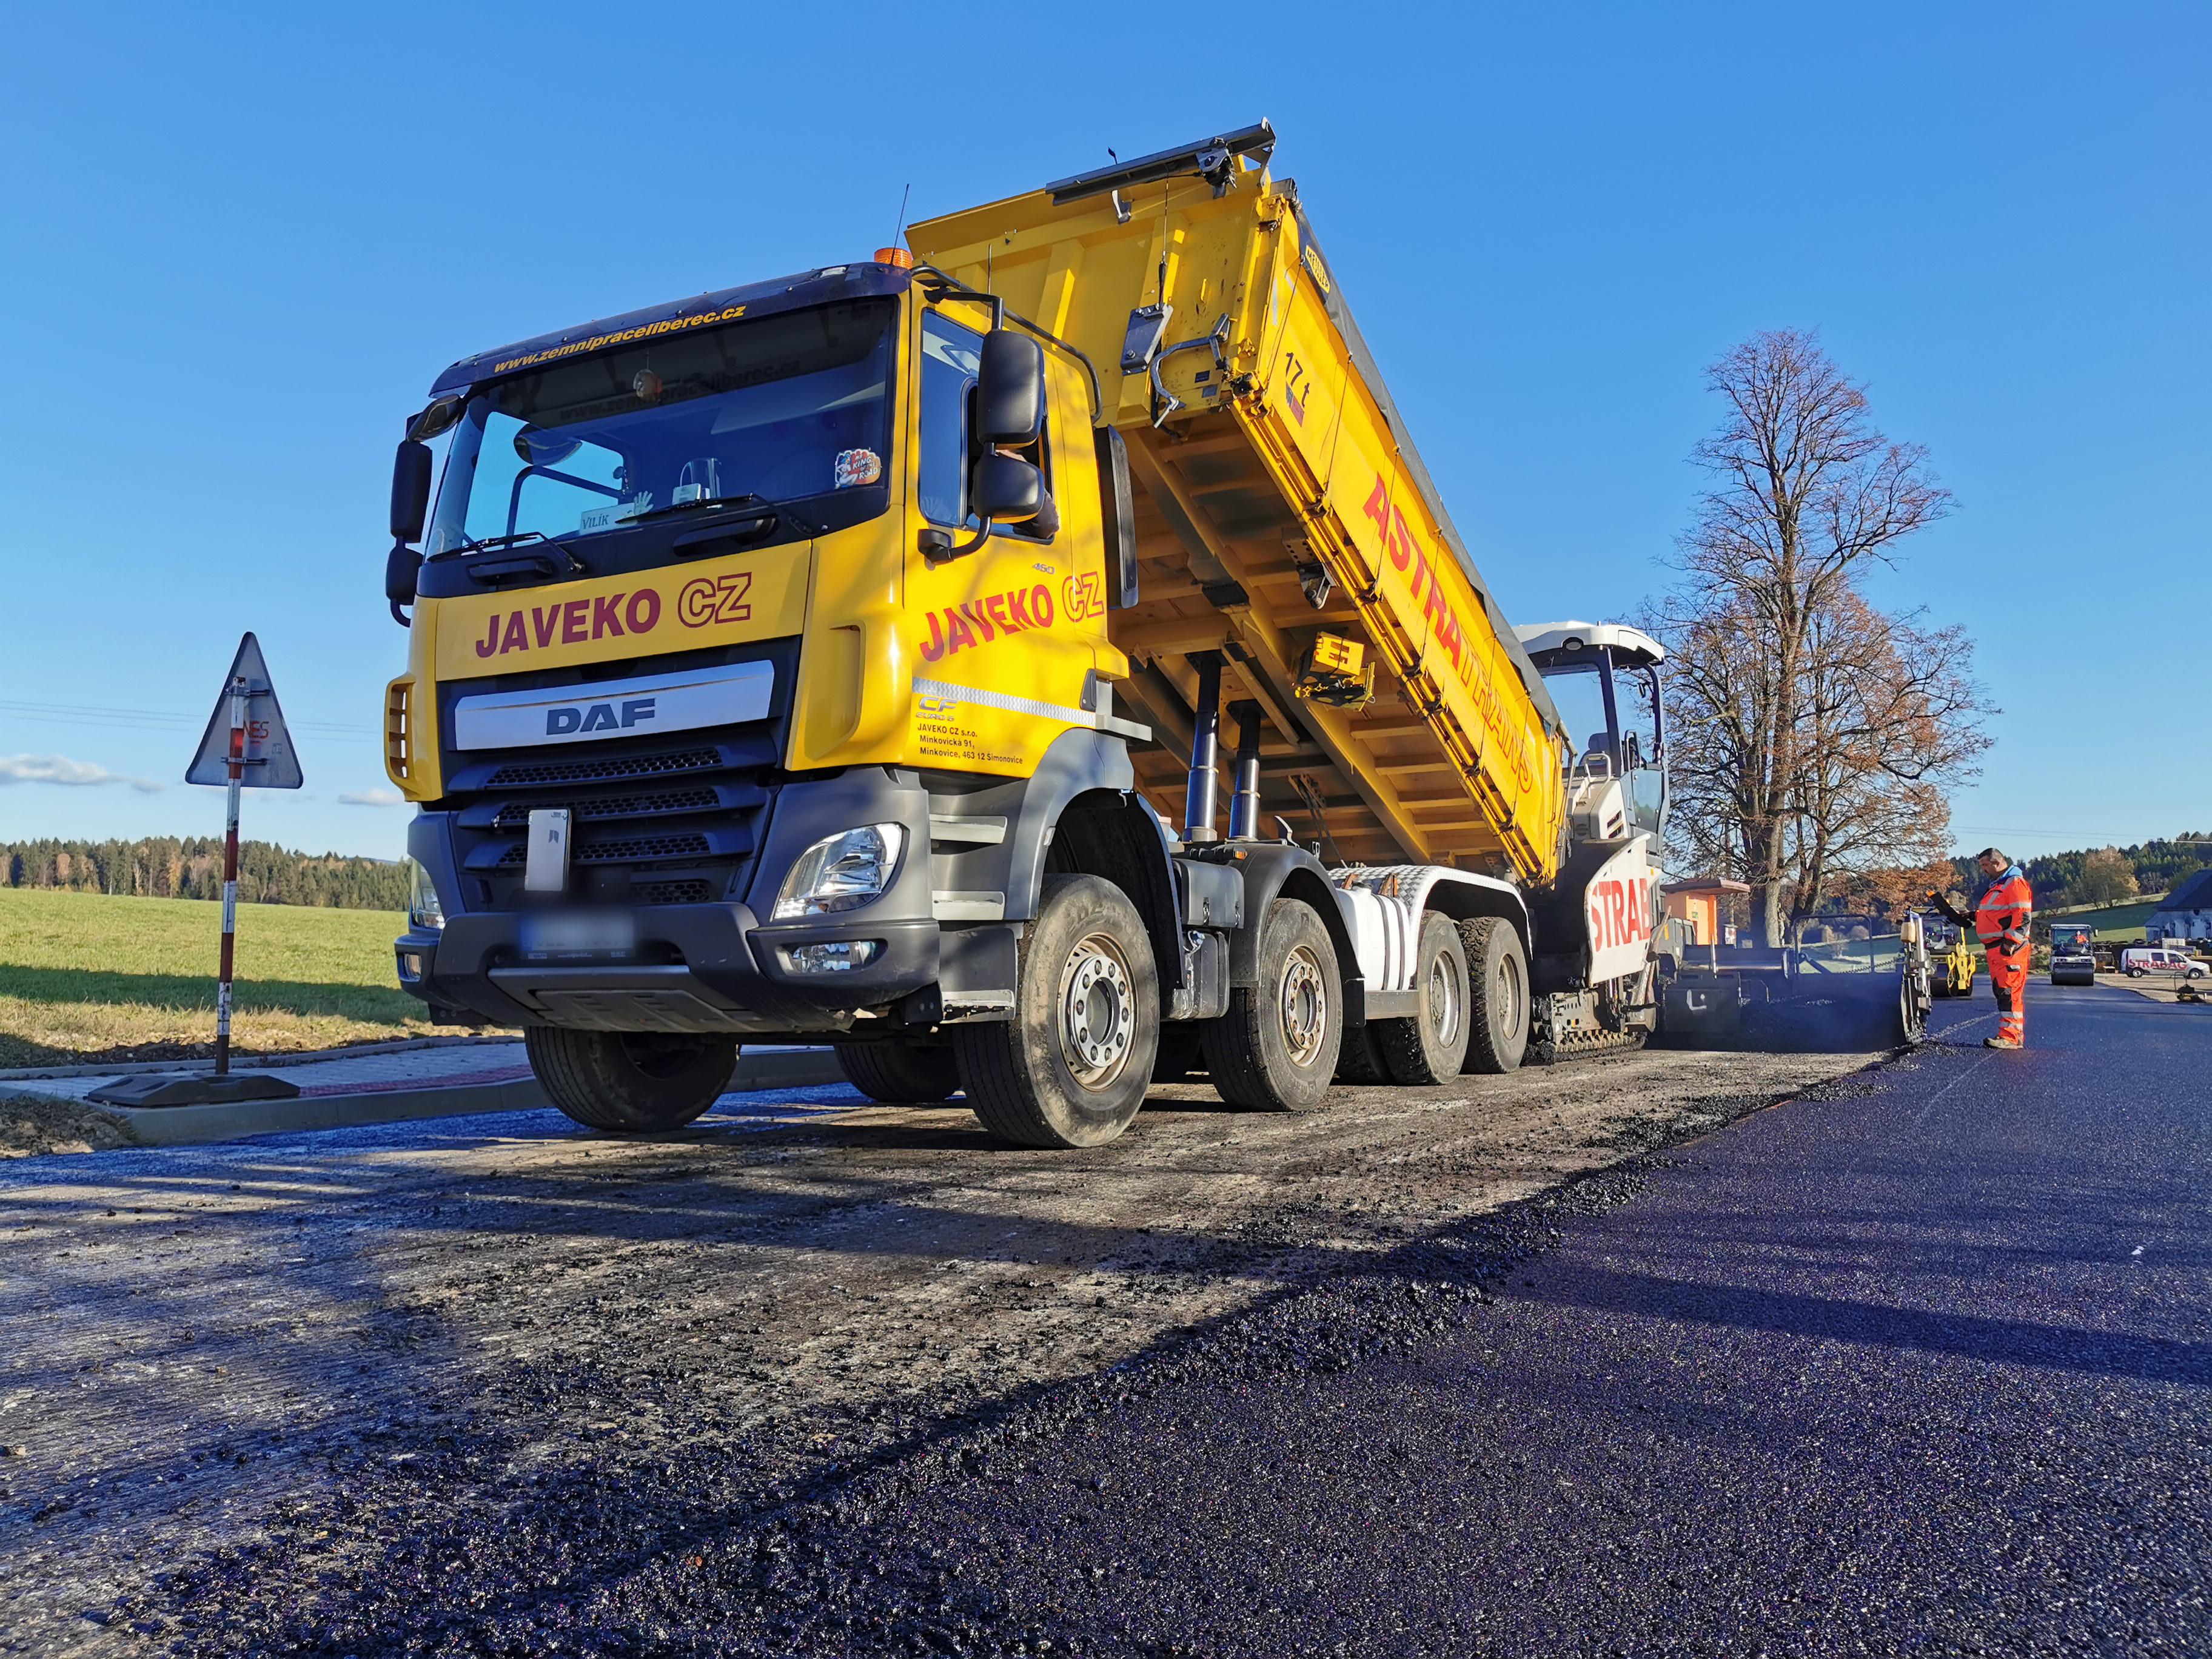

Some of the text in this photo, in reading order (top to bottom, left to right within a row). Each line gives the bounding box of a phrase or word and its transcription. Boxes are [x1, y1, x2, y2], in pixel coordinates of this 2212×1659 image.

[493, 305, 747, 373] www.zemnipraceliberec.cz
[1285, 352, 1310, 408] 17 t
[853, 457, 872, 469] KING
[859, 467, 879, 480] ROAD
[582, 513, 609, 529] VILÍK
[1032, 563, 1055, 574] 460
[475, 572, 752, 659] JAVEKO CZ
[919, 571, 1105, 662] JAVEKO CZ
[919, 695, 957, 712] CF
[546, 697, 655, 736] DAF
[917, 723, 947, 734] JAVEKO
[920, 735, 974, 749] Minkovická 91,
[920, 747, 960, 759] Minkovice,
[2128, 959, 2188, 970] STRABAG
